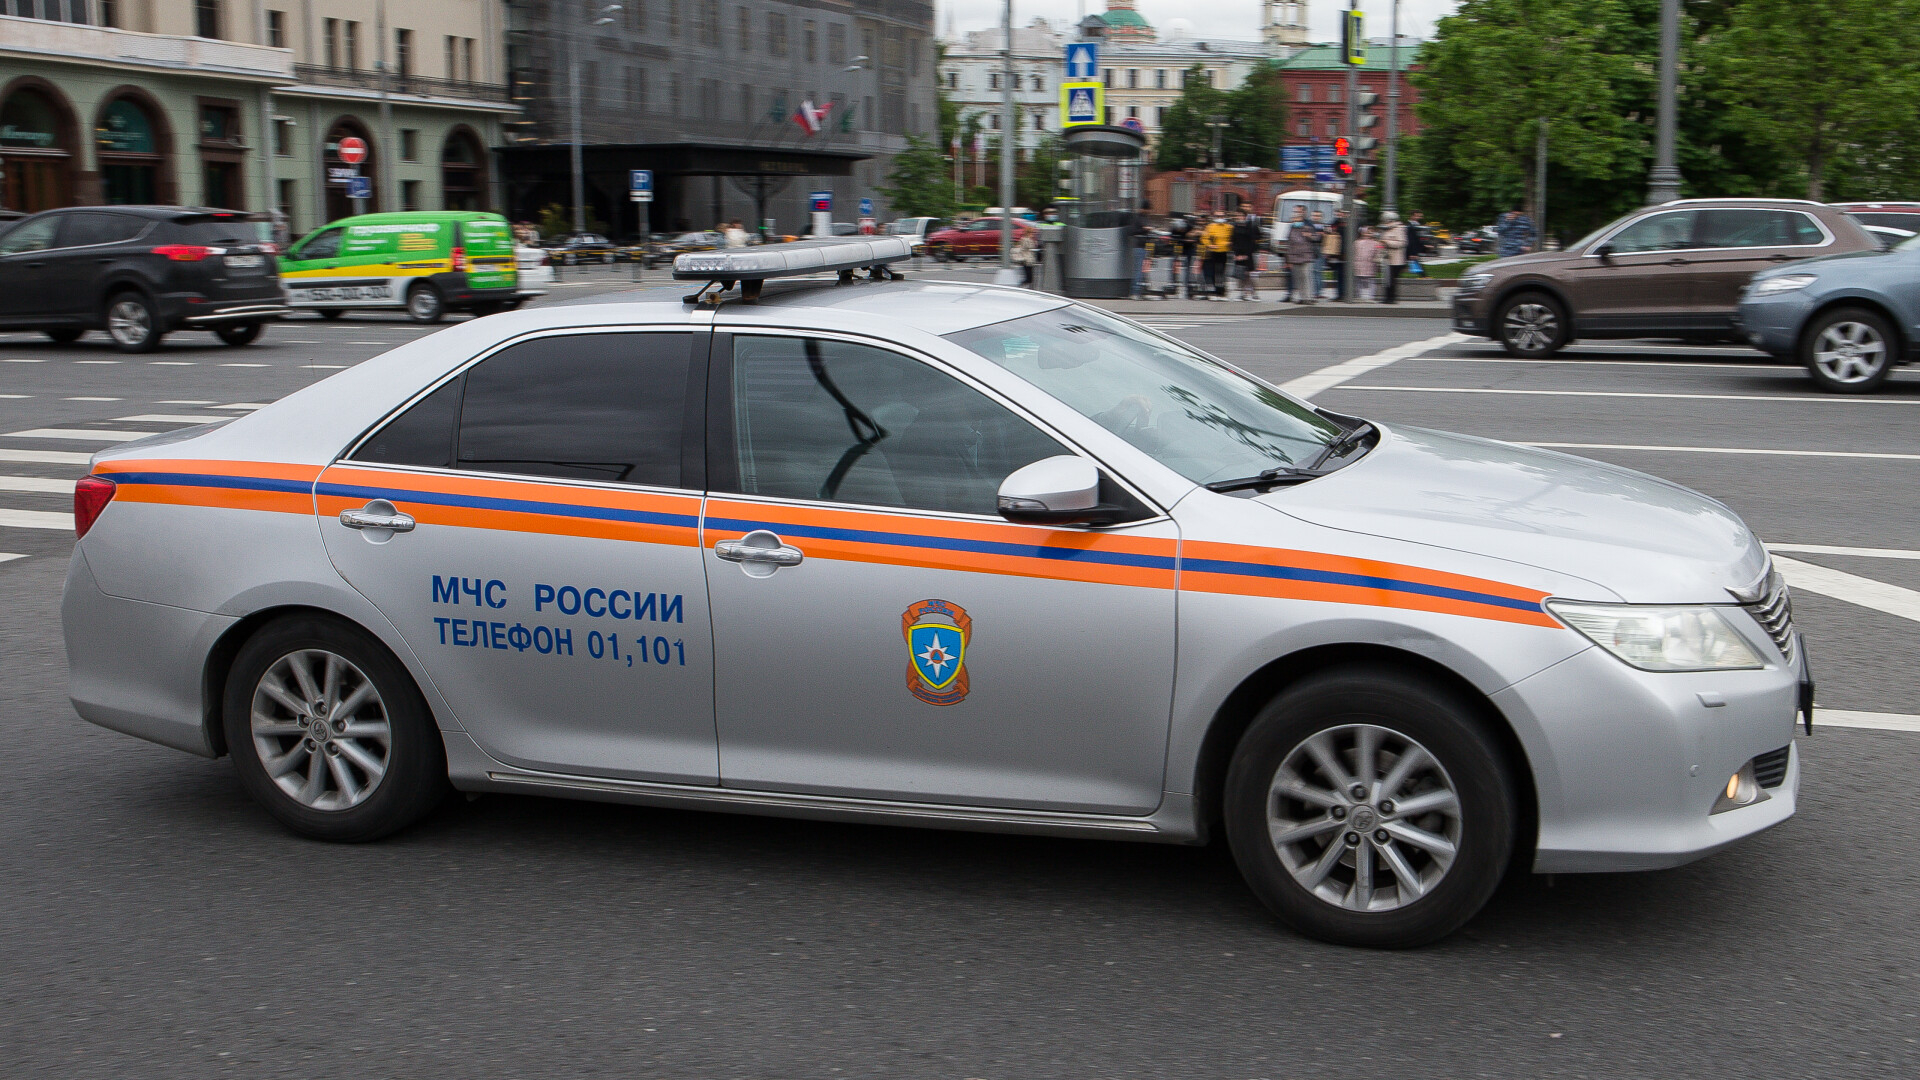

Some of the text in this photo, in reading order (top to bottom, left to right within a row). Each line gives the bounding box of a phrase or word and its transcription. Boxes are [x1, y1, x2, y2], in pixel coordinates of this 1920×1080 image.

[432, 575, 683, 624] МЧС РОССИИ
[434, 617, 686, 667] ТЕЛЕФОН 01,101
